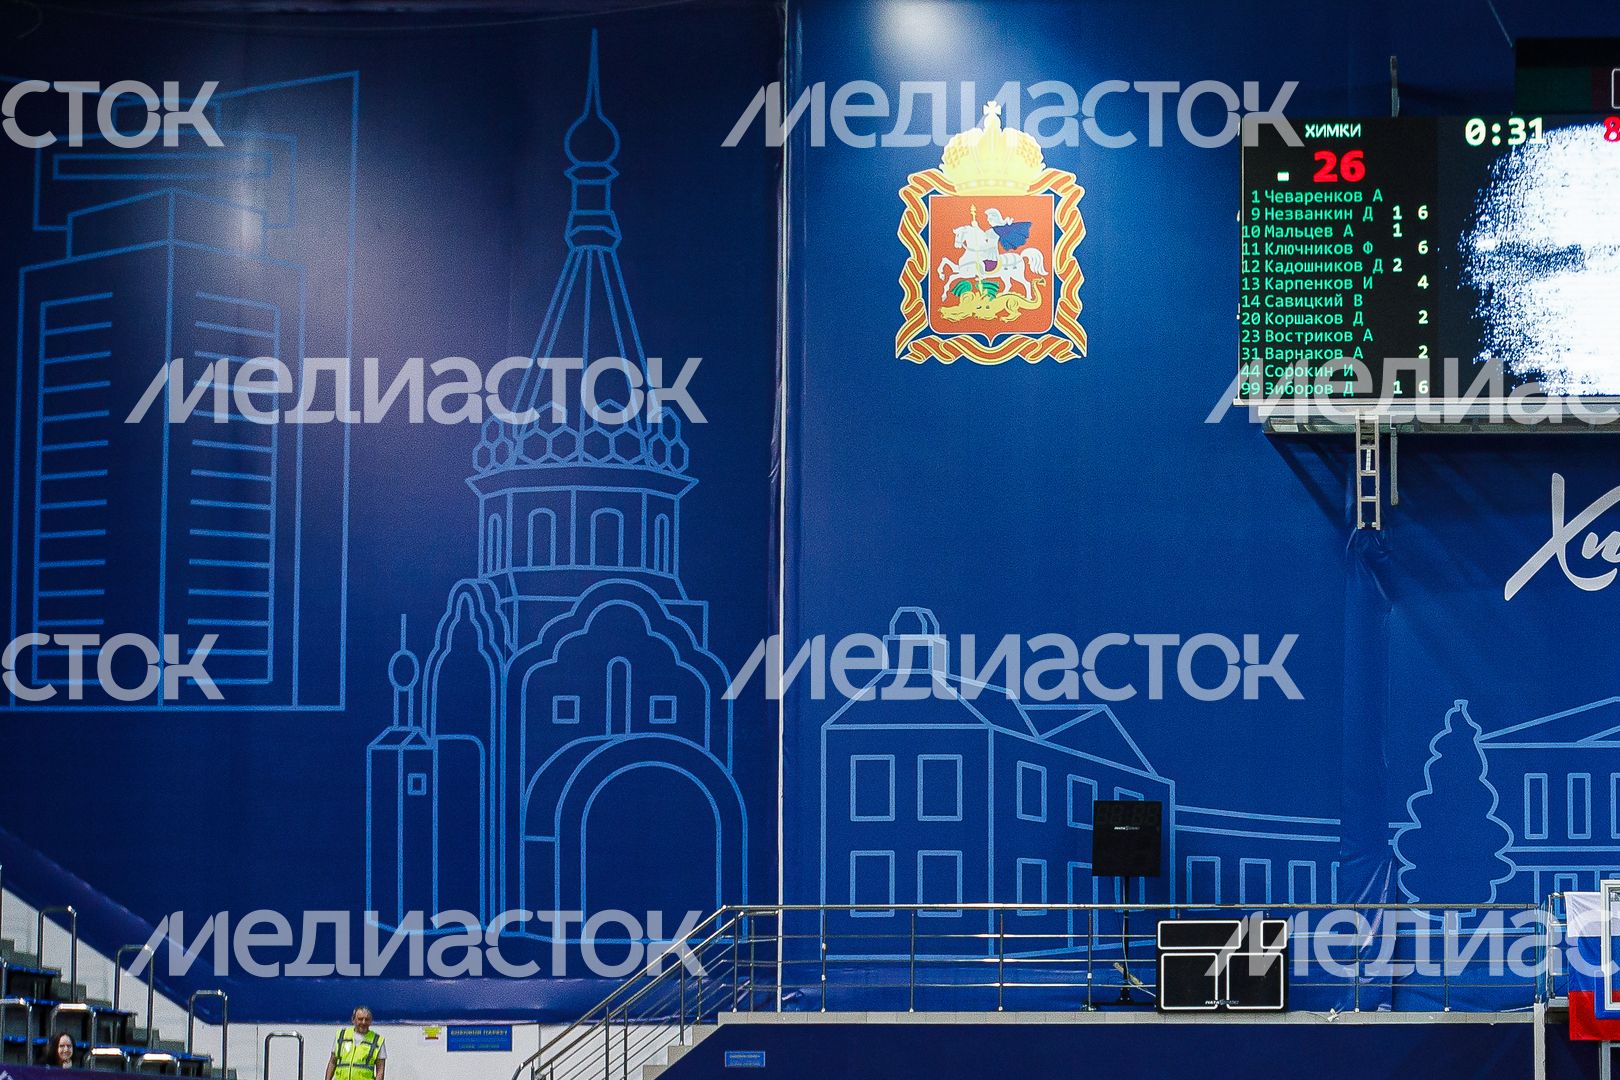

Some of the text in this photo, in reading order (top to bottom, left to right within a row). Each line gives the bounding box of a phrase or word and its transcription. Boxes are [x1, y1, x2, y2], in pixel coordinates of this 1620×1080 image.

[1305, 123, 1361, 138] ХИМКИ
[1464, 117, 1547, 146] 0:31
[1313, 150, 1366, 182] 26
[1251, 188, 1383, 205] 1 Чеваренков А
[1251, 205, 1428, 222] 9 Незванкин Д 1 6
[1242, 223, 1402, 240] 10 Мальцев А 1
[1242, 240, 1428, 256] 11 Ключников Ф 6
[1242, 258, 1402, 275] 12 Кадошников Д 2
[1241, 275, 1428, 292] 13 Карпенков И 4
[1241, 293, 1363, 309] 14 Савицкий В
[1240, 310, 1428, 327] 20 Коршаков Д 2
[1241, 328, 1373, 345] 23 Востриков А
[1241, 345, 1429, 362] 31 Варнаков А 2
